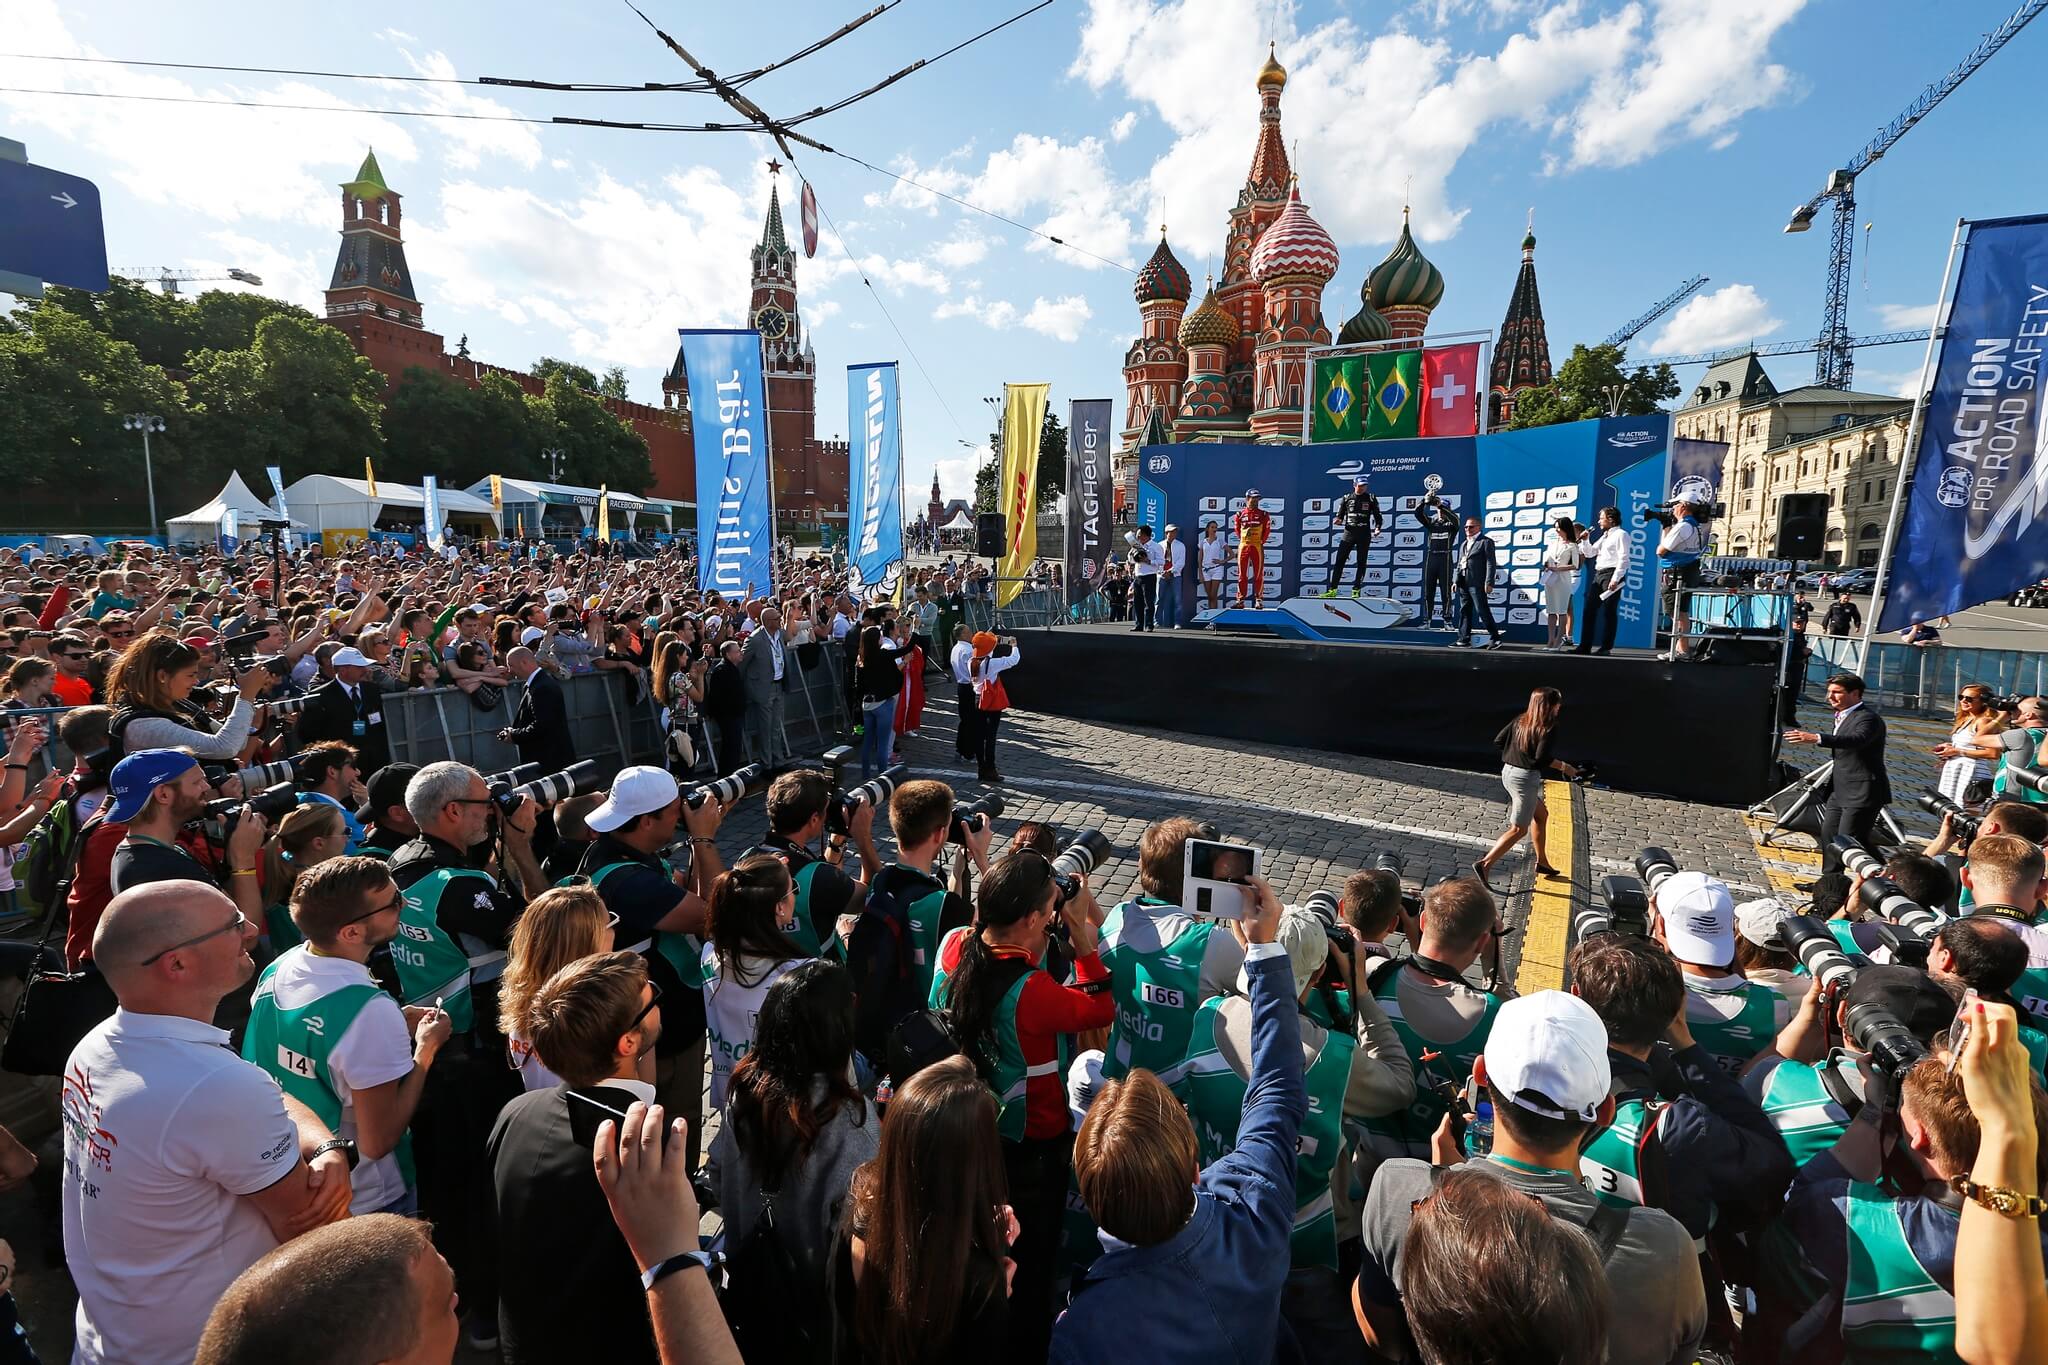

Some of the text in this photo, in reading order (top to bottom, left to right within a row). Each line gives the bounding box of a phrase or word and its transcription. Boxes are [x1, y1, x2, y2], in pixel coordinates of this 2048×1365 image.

[1946, 337, 2012, 463] ACTION
[1981, 398, 2028, 471] ROAD
[1149, 457, 1170, 472] FIA
[610, 500, 644, 511] RACEBOOTH
[1971, 475, 1999, 512] FOR
[1619, 489, 1650, 622] #FanBoost
[1995, 906, 2026, 920] Nikon
[400, 922, 428, 941] 163
[389, 942, 426, 968] edia
[1145, 985, 1180, 1006] 166
[286, 1050, 309, 1075] 14
[1601, 1167, 1618, 1193] 3
